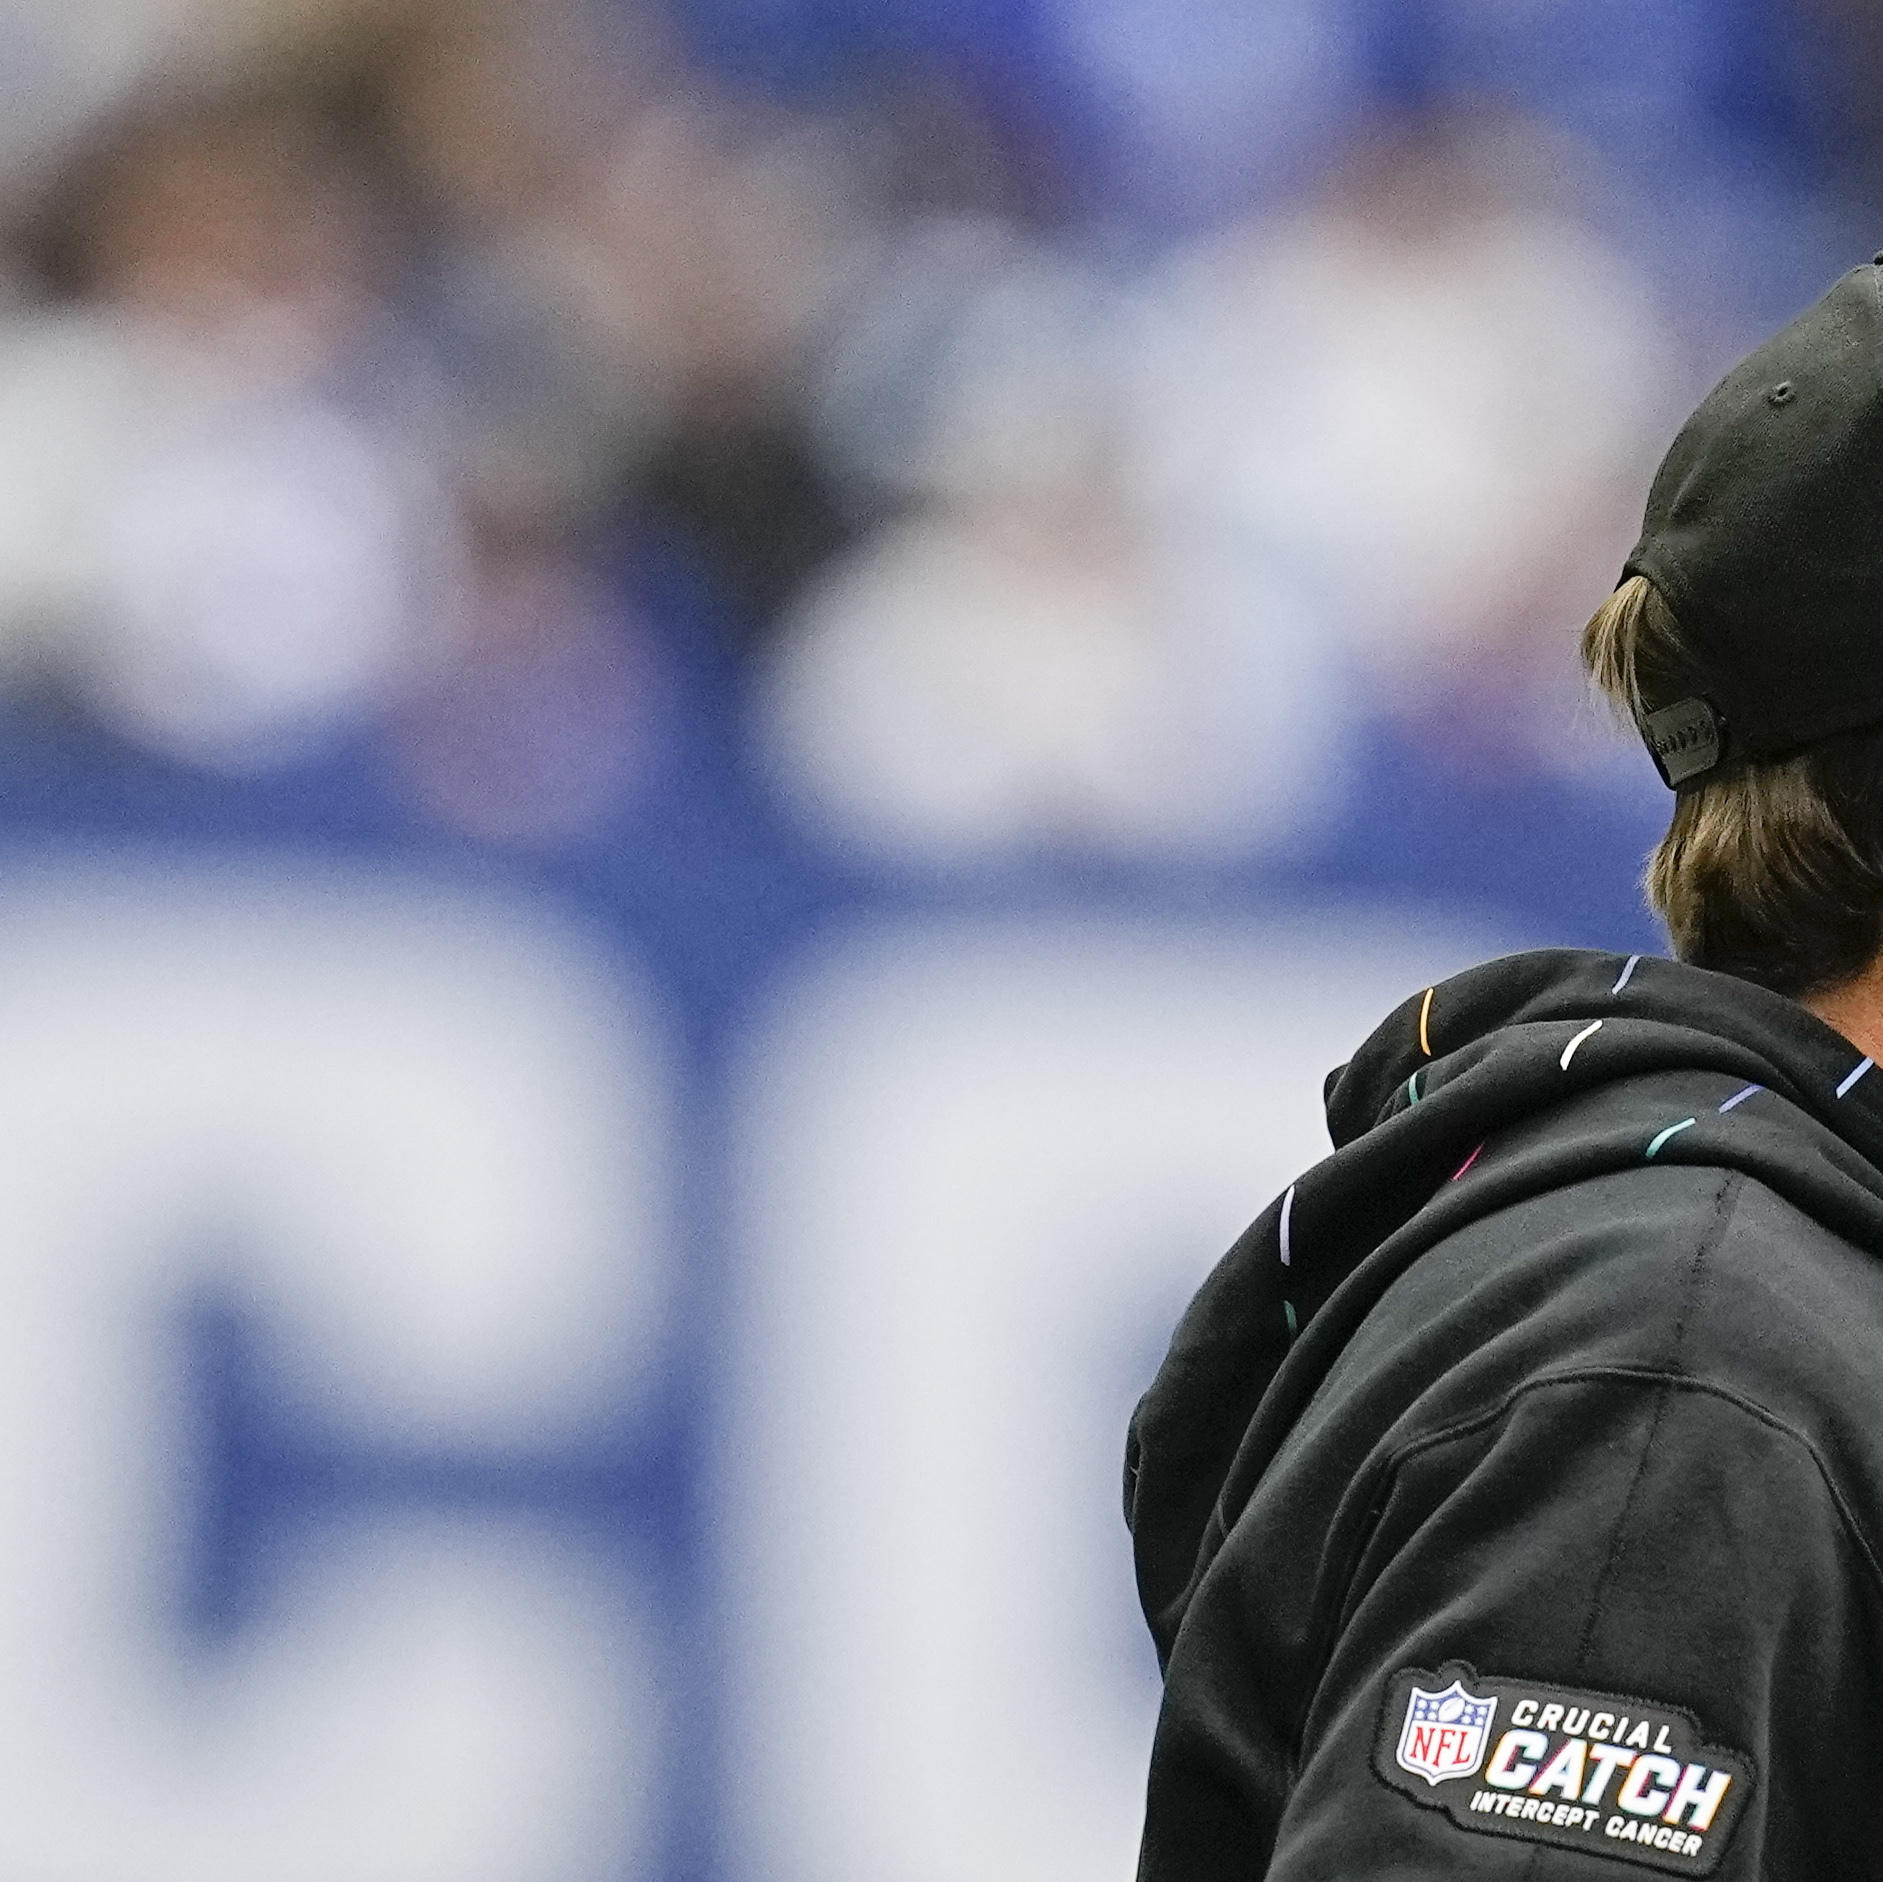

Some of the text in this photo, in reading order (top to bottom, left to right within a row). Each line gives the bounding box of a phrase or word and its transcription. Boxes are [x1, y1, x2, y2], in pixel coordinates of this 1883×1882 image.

[1409, 1725, 1472, 1768] NFL
[1511, 1699, 1674, 1755] CRUCIAL
[1485, 1729, 1732, 1832] CATCH
[1470, 1790, 1704, 1858] INTERCEPT CANCER
